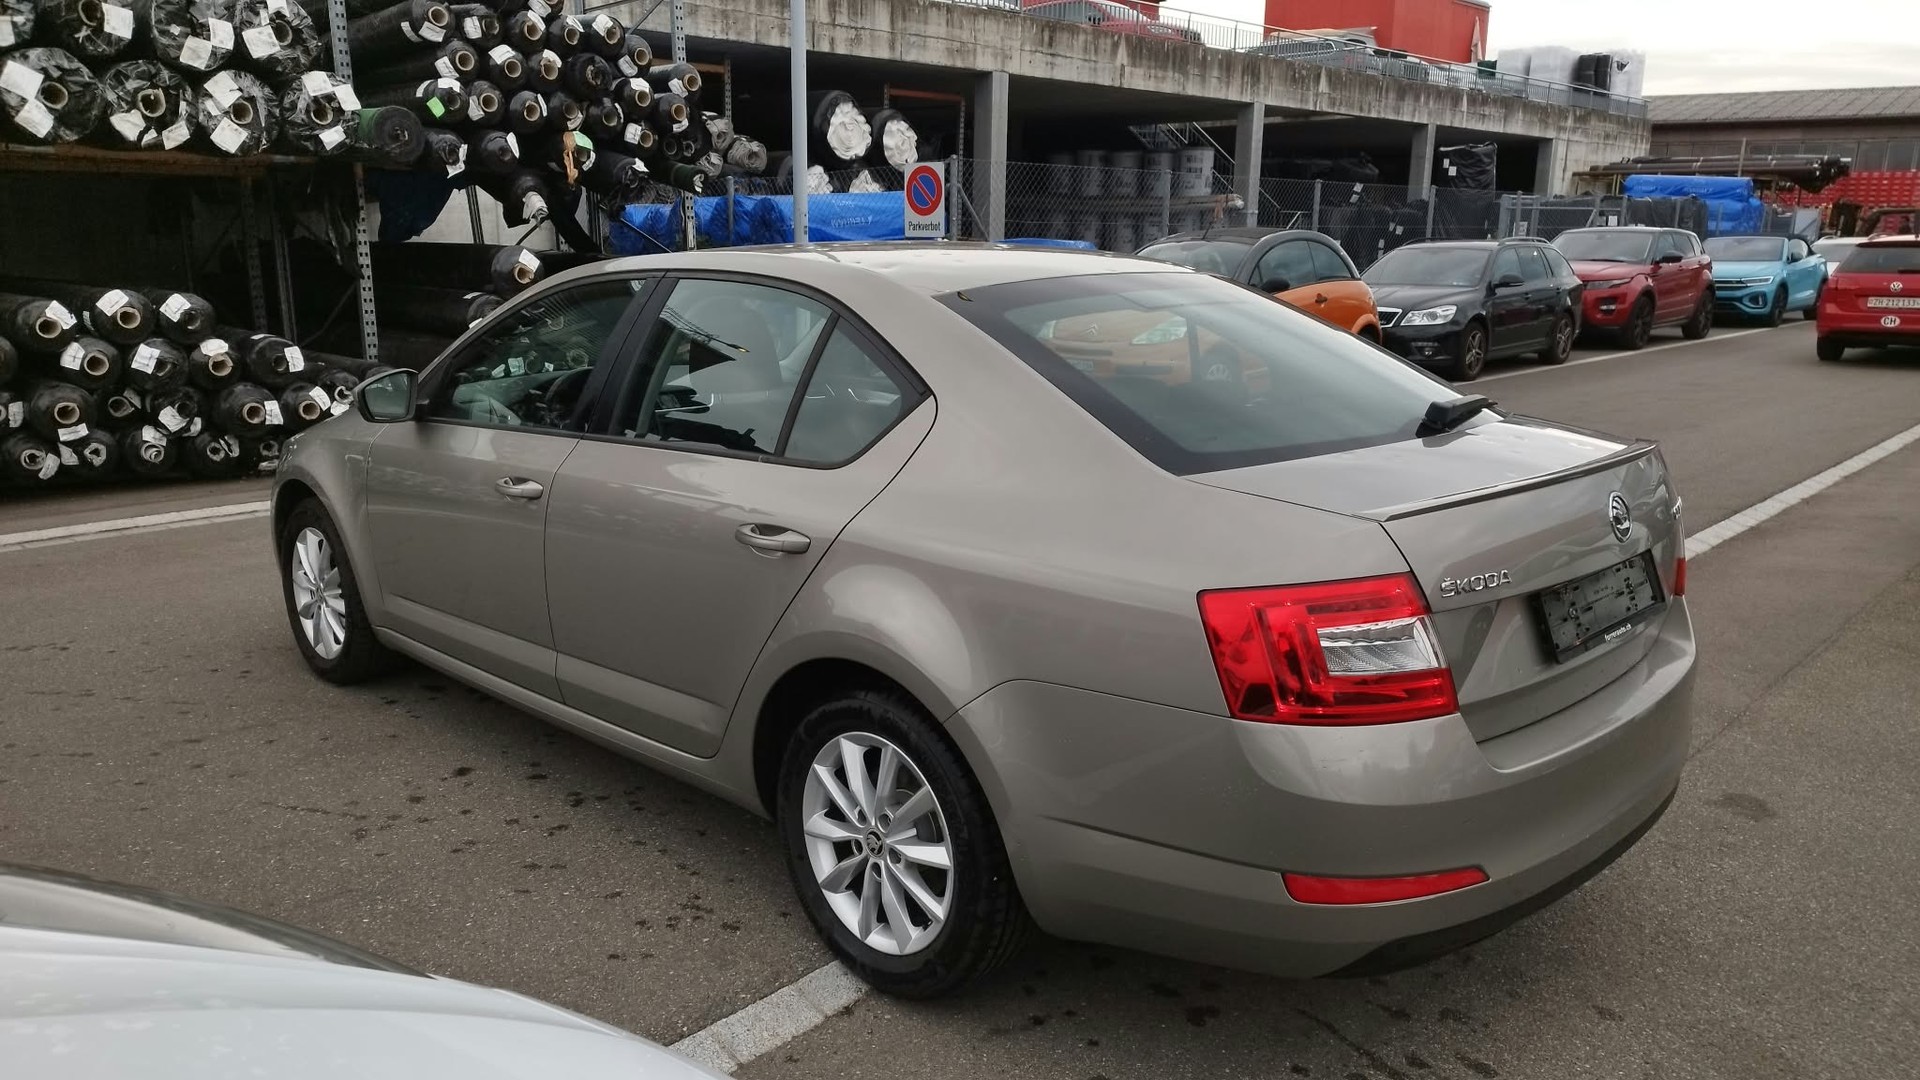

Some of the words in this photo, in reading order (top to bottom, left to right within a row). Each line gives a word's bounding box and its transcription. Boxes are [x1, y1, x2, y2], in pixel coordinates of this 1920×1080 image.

[908, 220, 941, 232] Parkverbot
[1883, 317, 1897, 325] CH
[1440, 569, 1512, 598] ŠKODA
